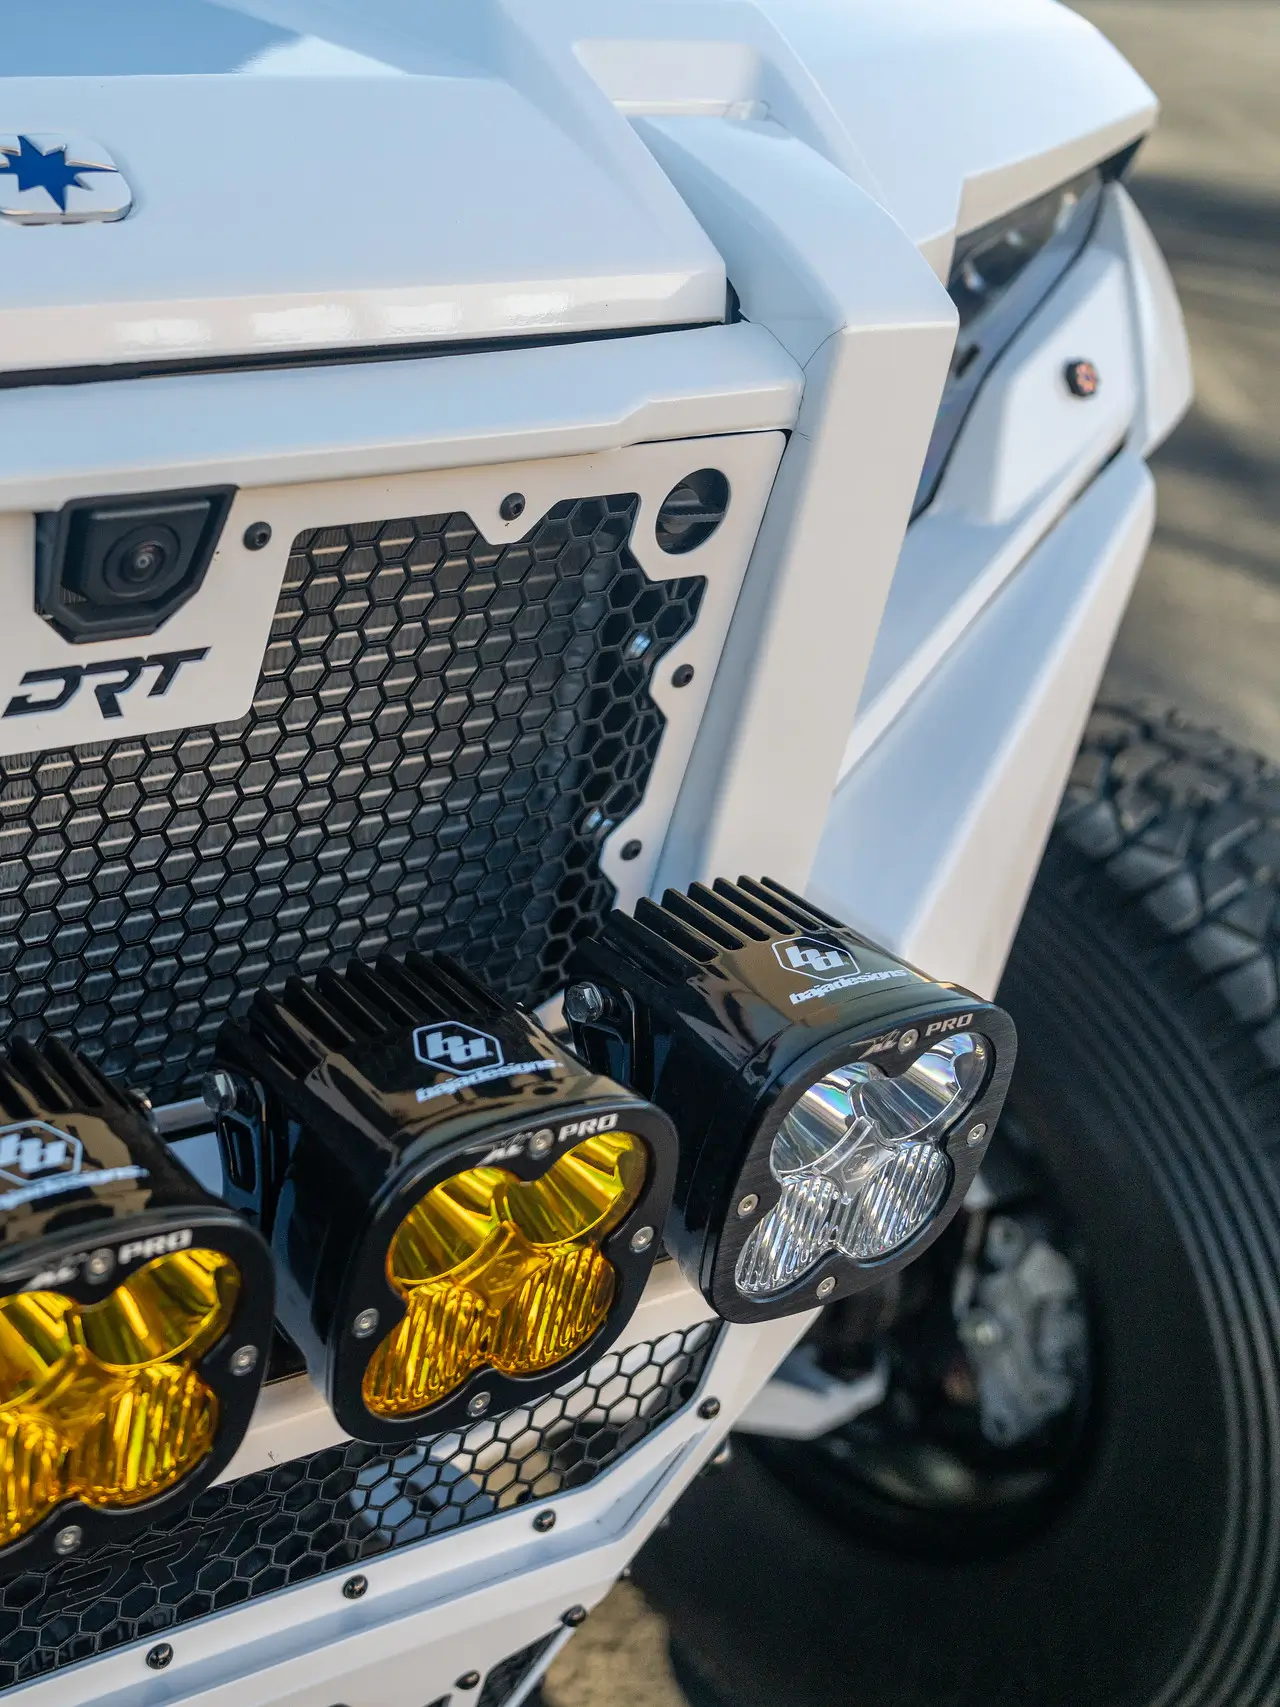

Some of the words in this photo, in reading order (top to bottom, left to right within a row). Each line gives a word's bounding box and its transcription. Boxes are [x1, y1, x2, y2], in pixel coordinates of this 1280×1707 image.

[1, 646, 212, 719] DRT
[789, 970, 907, 1005] bajadesigns
[925, 1013, 973, 1037] PRO
[558, 1113, 619, 1142] PRO
